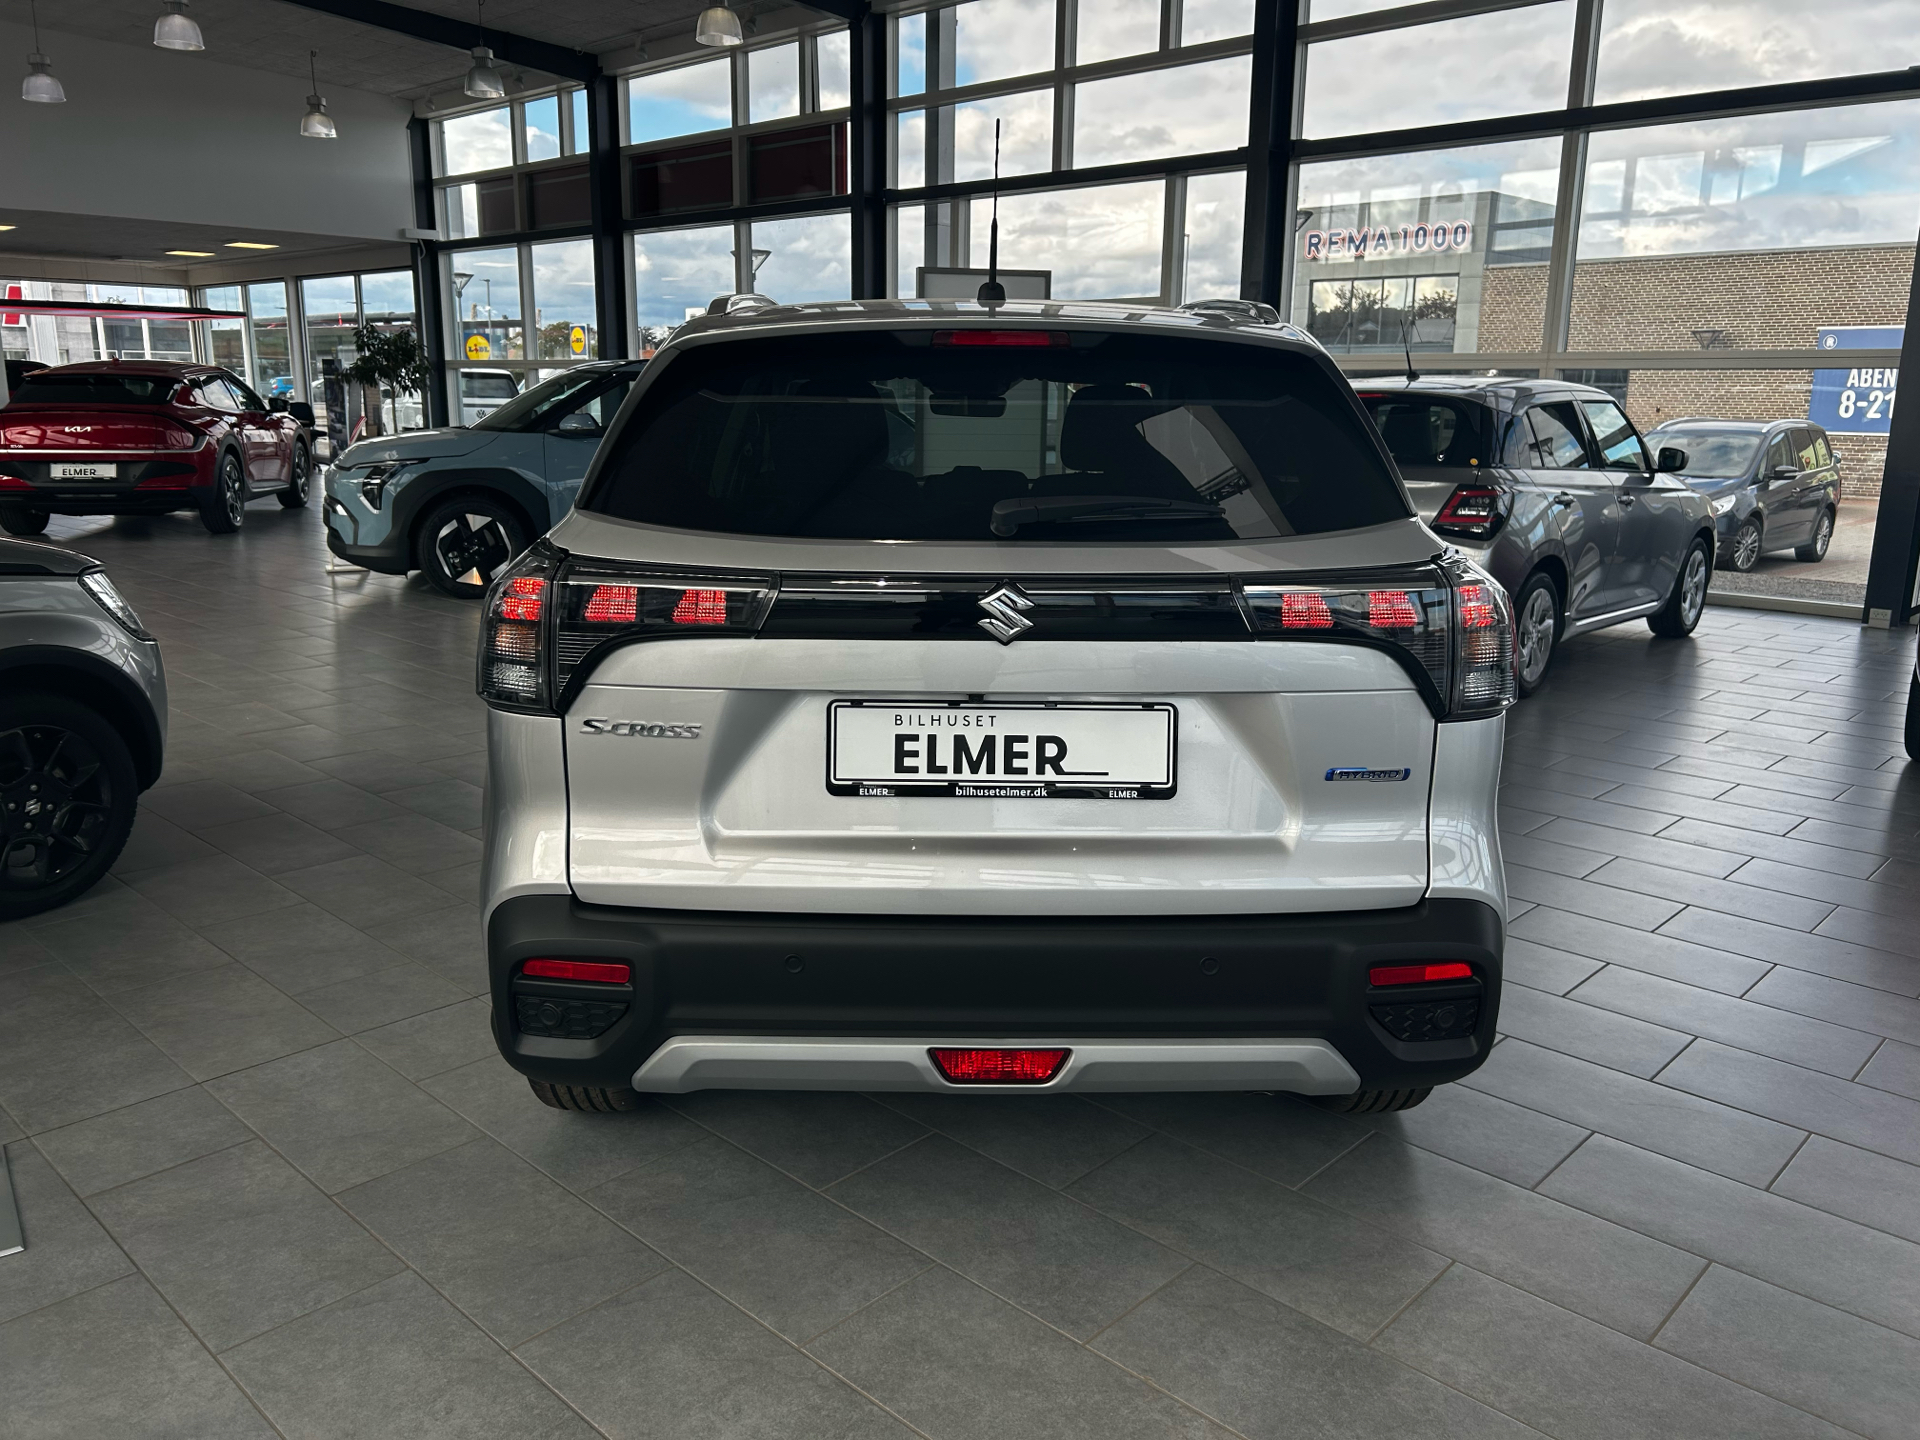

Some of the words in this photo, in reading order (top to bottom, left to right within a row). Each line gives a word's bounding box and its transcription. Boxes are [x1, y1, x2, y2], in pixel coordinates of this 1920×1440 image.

[1304, 226, 1393, 259] REMA
[1398, 219, 1471, 252] 1000
[62, 468, 97, 476] ELMER
[894, 714, 997, 727] BILHUSET
[894, 733, 1108, 776] ELMER
[1339, 770, 1400, 779] HYBRID
[859, 788, 894, 796] ELMER
[955, 786, 1048, 797] bilhusetelmer.dk
[1109, 790, 1144, 798] ELMER
